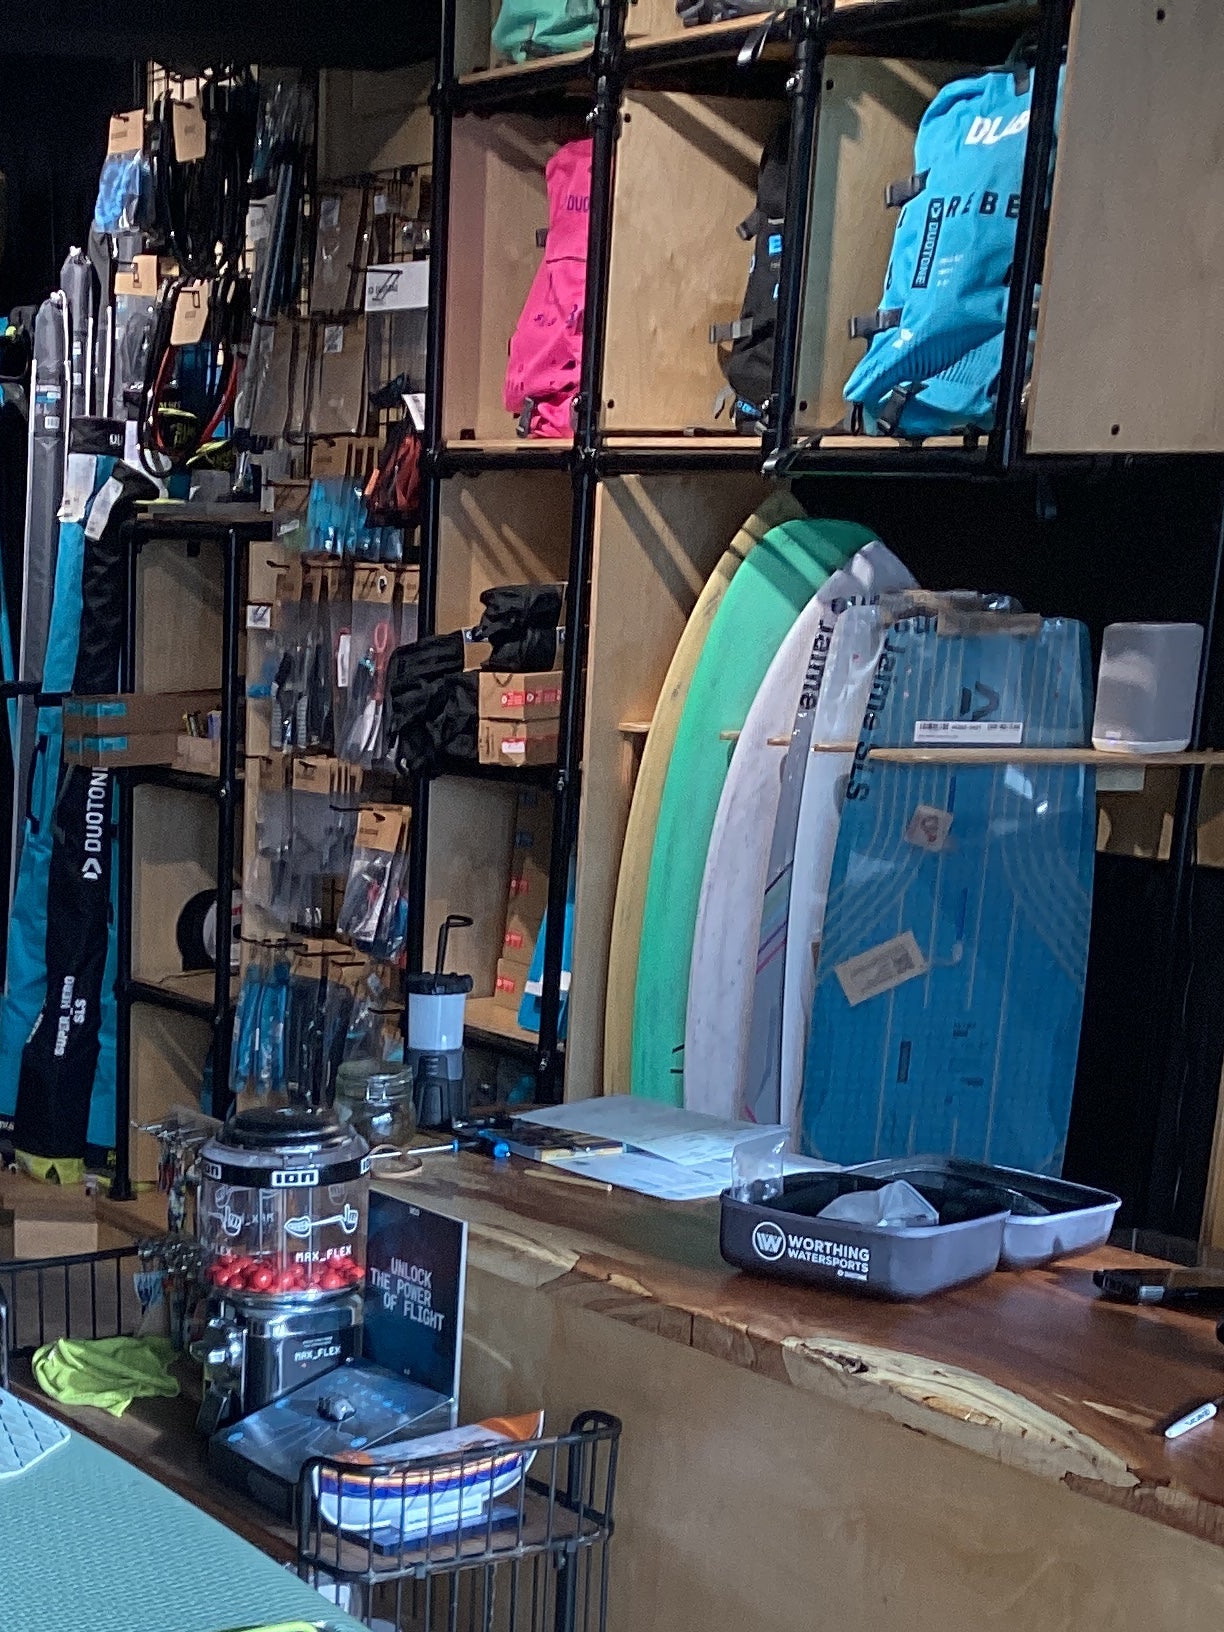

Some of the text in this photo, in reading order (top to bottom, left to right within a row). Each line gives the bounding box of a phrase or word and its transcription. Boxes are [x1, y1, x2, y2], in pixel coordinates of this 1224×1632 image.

[945, 191, 1021, 218] REBE
[914, 221, 940, 286] DUOTONE
[799, 619, 834, 711] Jaime
[84, 766, 109, 852] DUOTON
[73, 998, 87, 1024] SLS
[295, 1245, 353, 1263] MAX_FLEX
[787, 1247, 869, 1273] WATERSPORTS
[788, 1234, 870, 1262] WORTHING
[370, 1267, 432, 1308] THE POWER
[390, 1257, 432, 1290] UNLOCK
[383, 1293, 445, 1332] OF FLIGHT
[294, 1345, 341, 1361] MAX_FLEX
